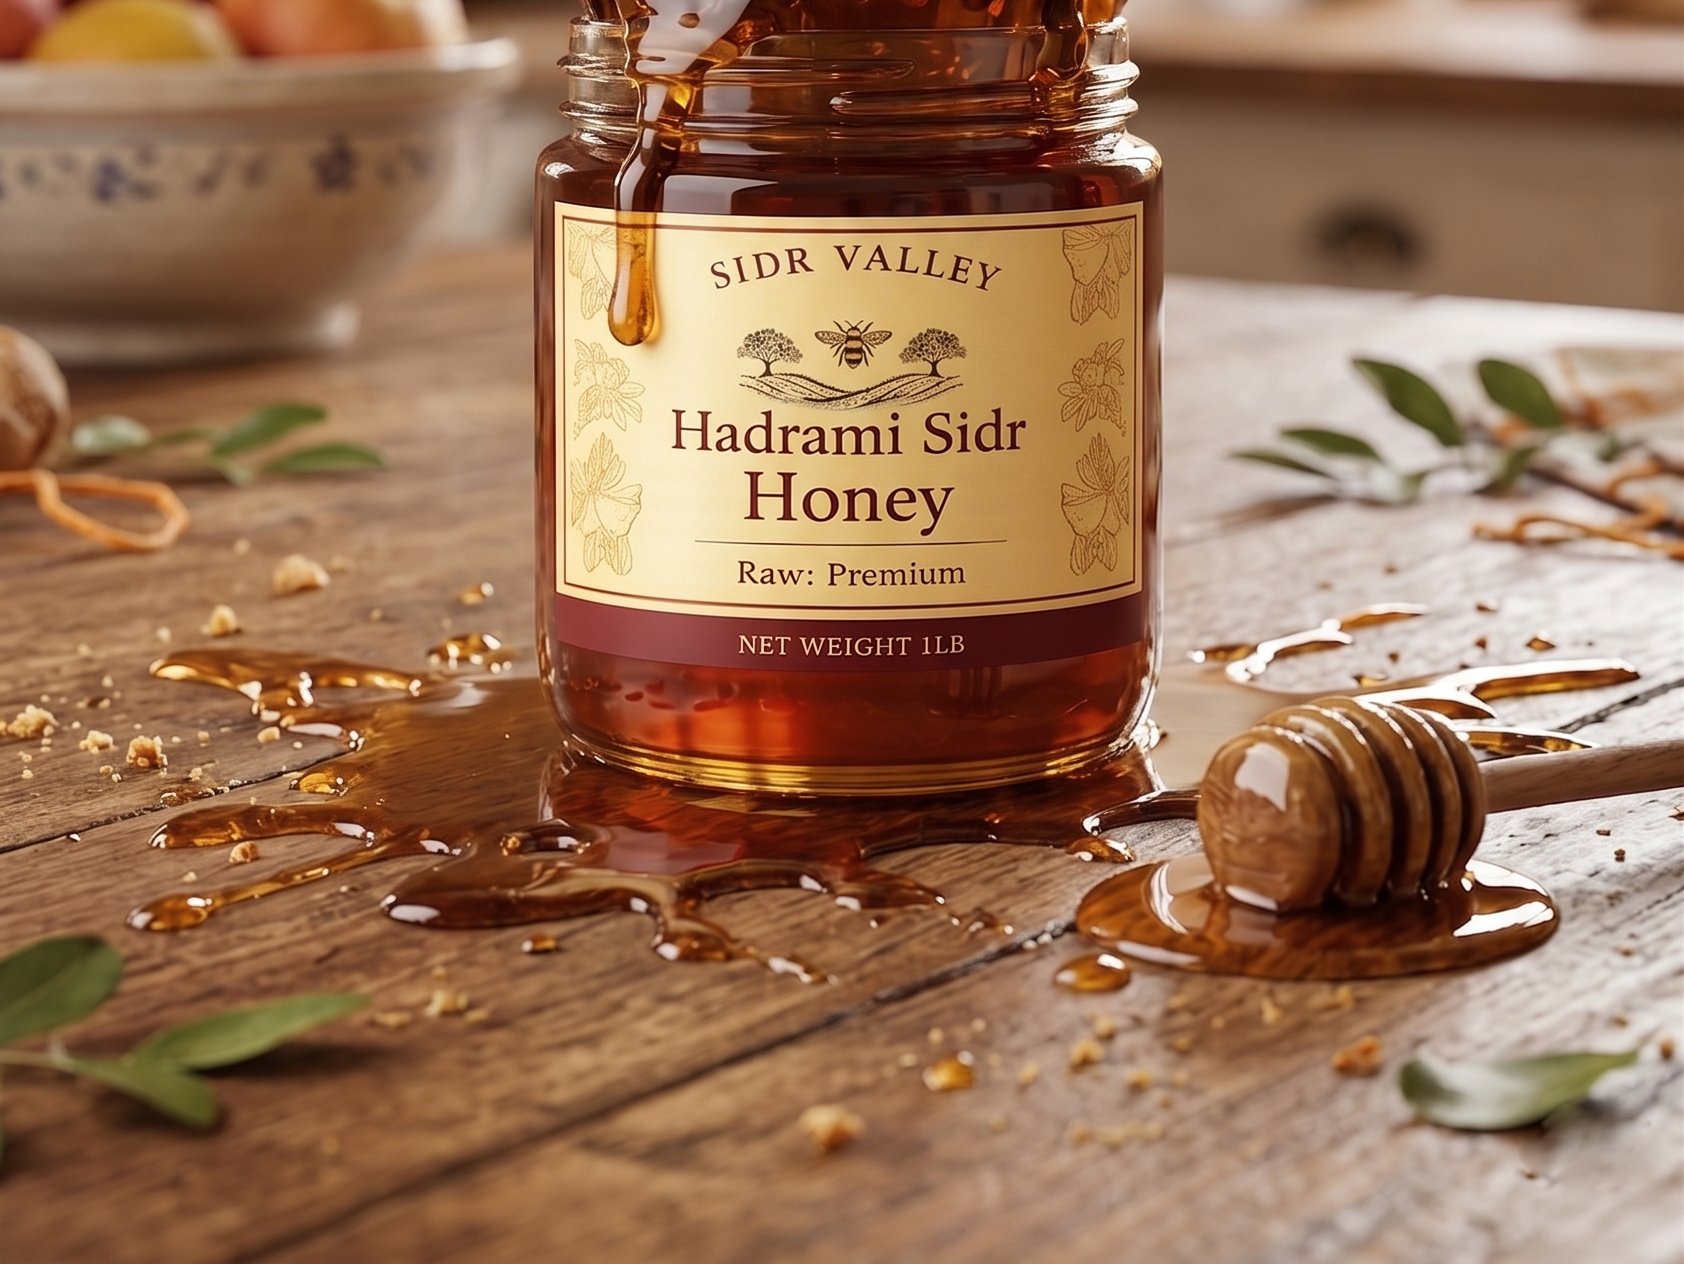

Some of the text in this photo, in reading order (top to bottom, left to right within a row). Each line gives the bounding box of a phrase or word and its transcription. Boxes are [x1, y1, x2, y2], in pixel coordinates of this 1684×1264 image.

[710, 244, 1003, 292] SIDR VALLEY
[671, 407, 1027, 456] Hadrami Sidr
[743, 471, 956, 537] Honey
[737, 560, 966, 587] Raw: Premium
[738, 634, 965, 657] NET WEIGHT 1LB
